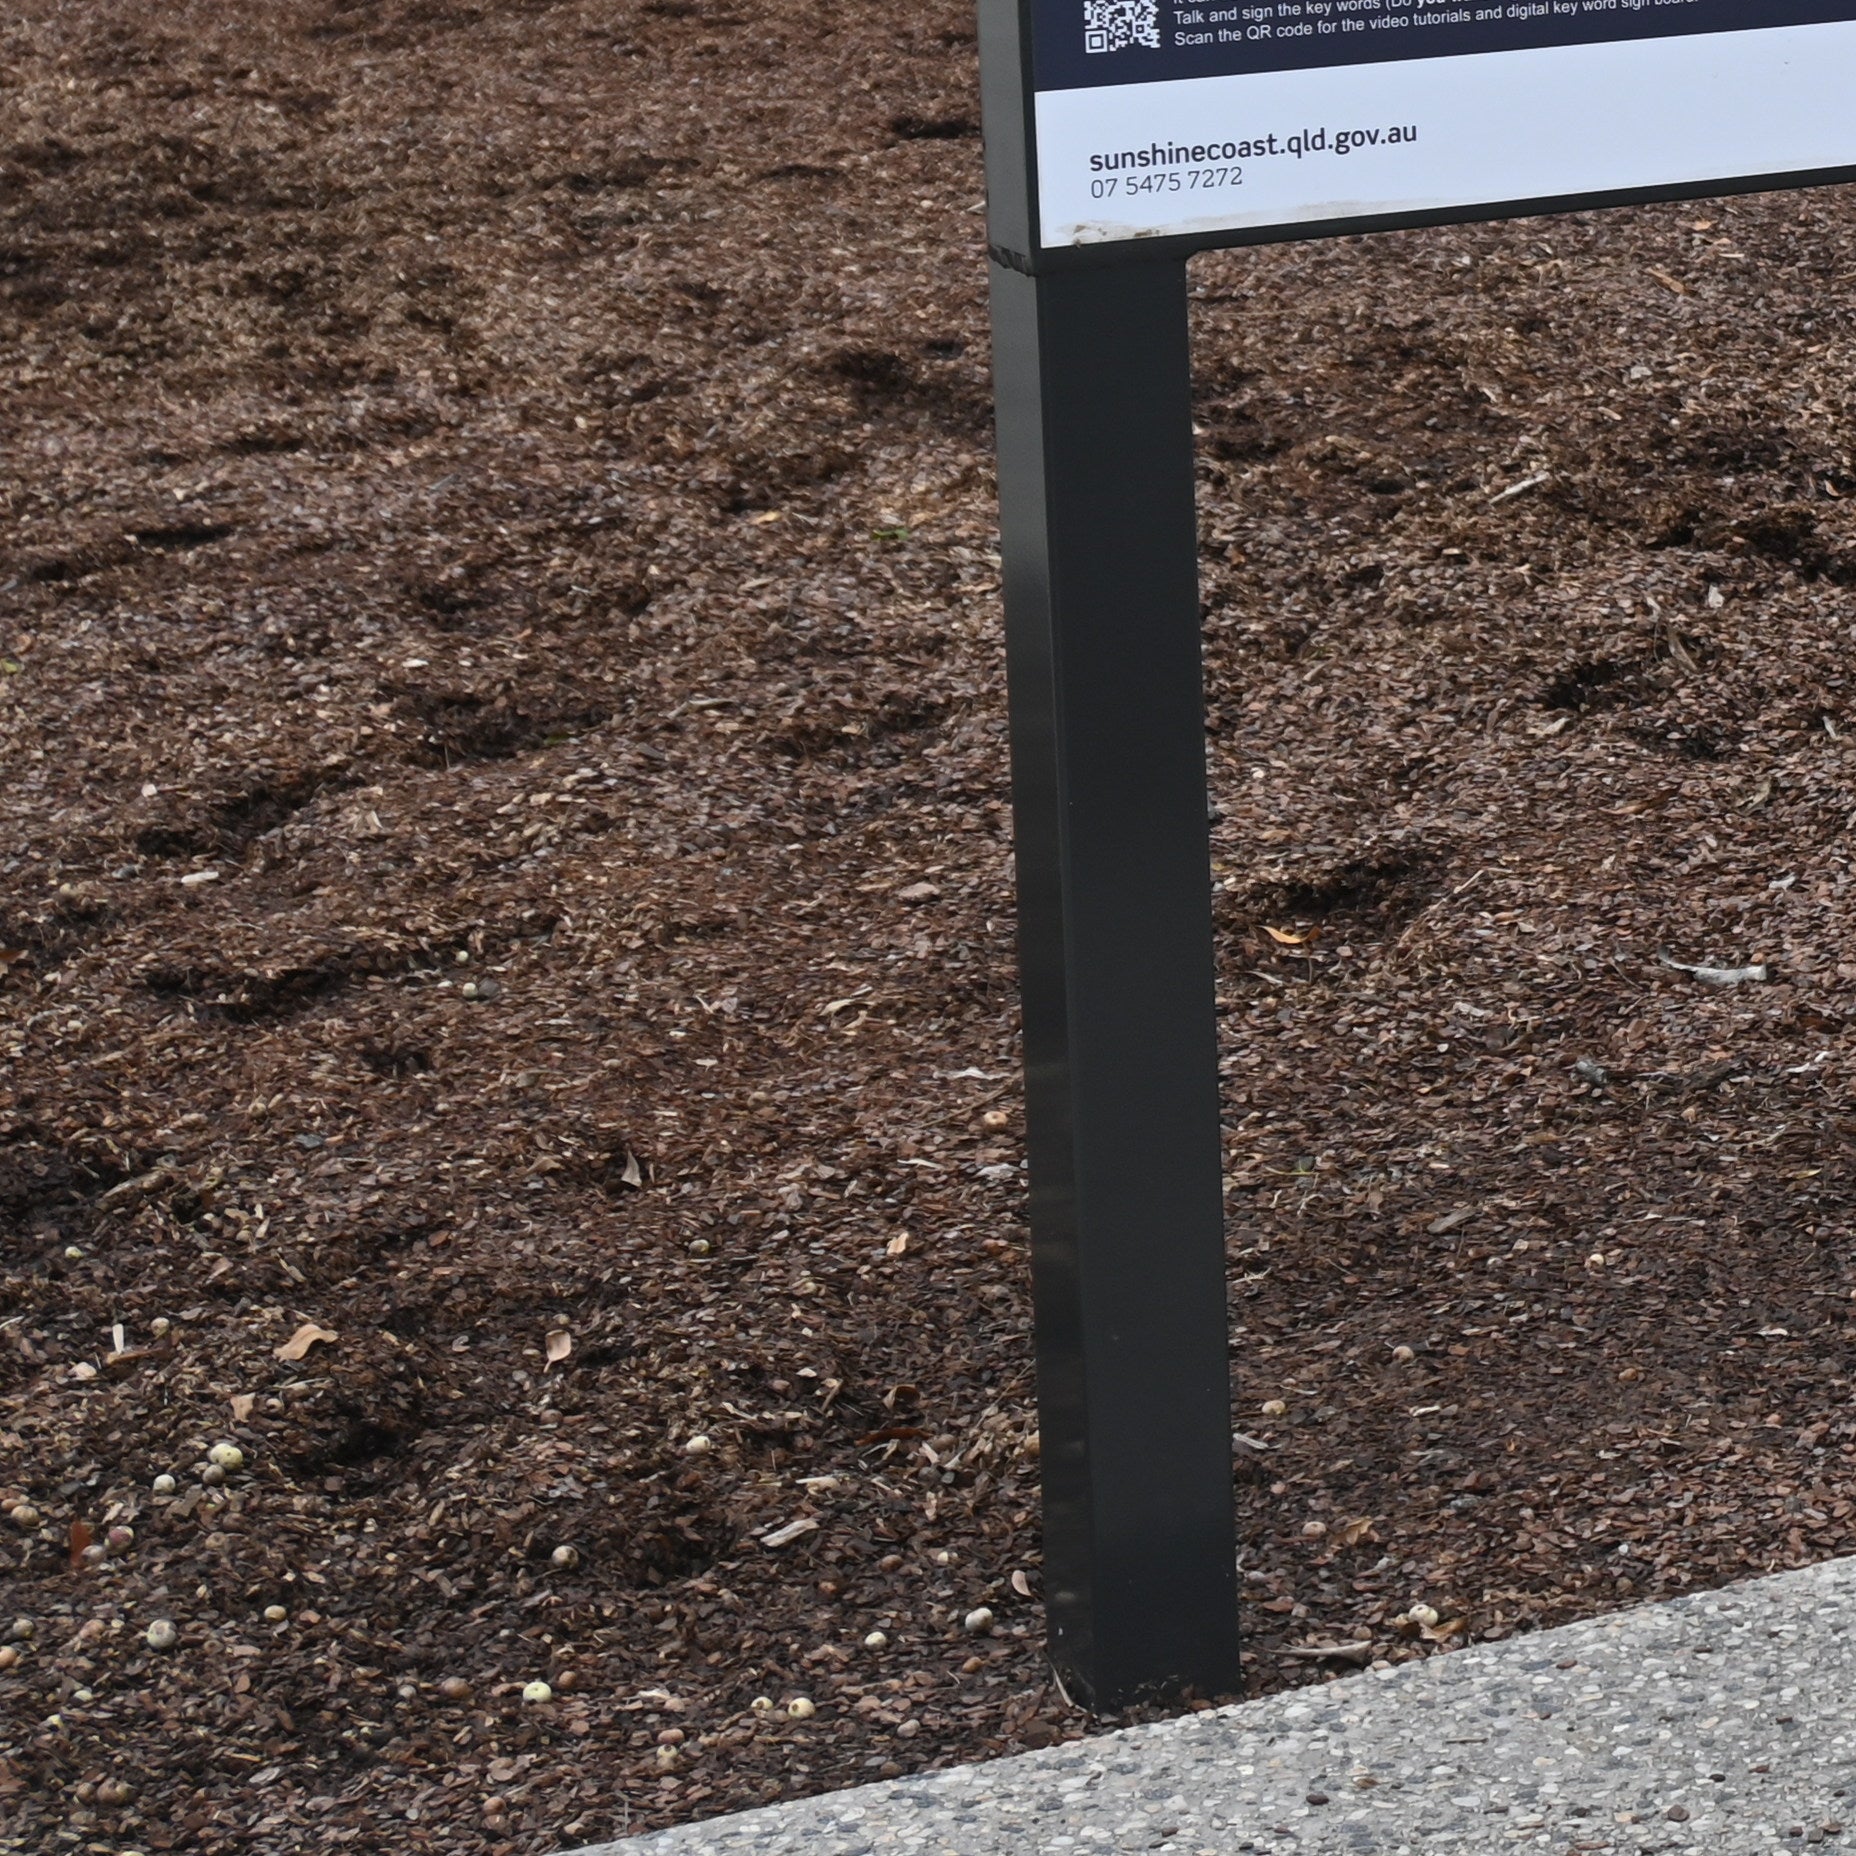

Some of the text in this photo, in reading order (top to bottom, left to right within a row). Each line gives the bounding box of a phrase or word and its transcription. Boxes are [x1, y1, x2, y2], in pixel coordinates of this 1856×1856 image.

[1089, 124, 1417, 172] sunshinecoast.qld.gov.au
[1090, 165, 1243, 199] 07 5475 7272
